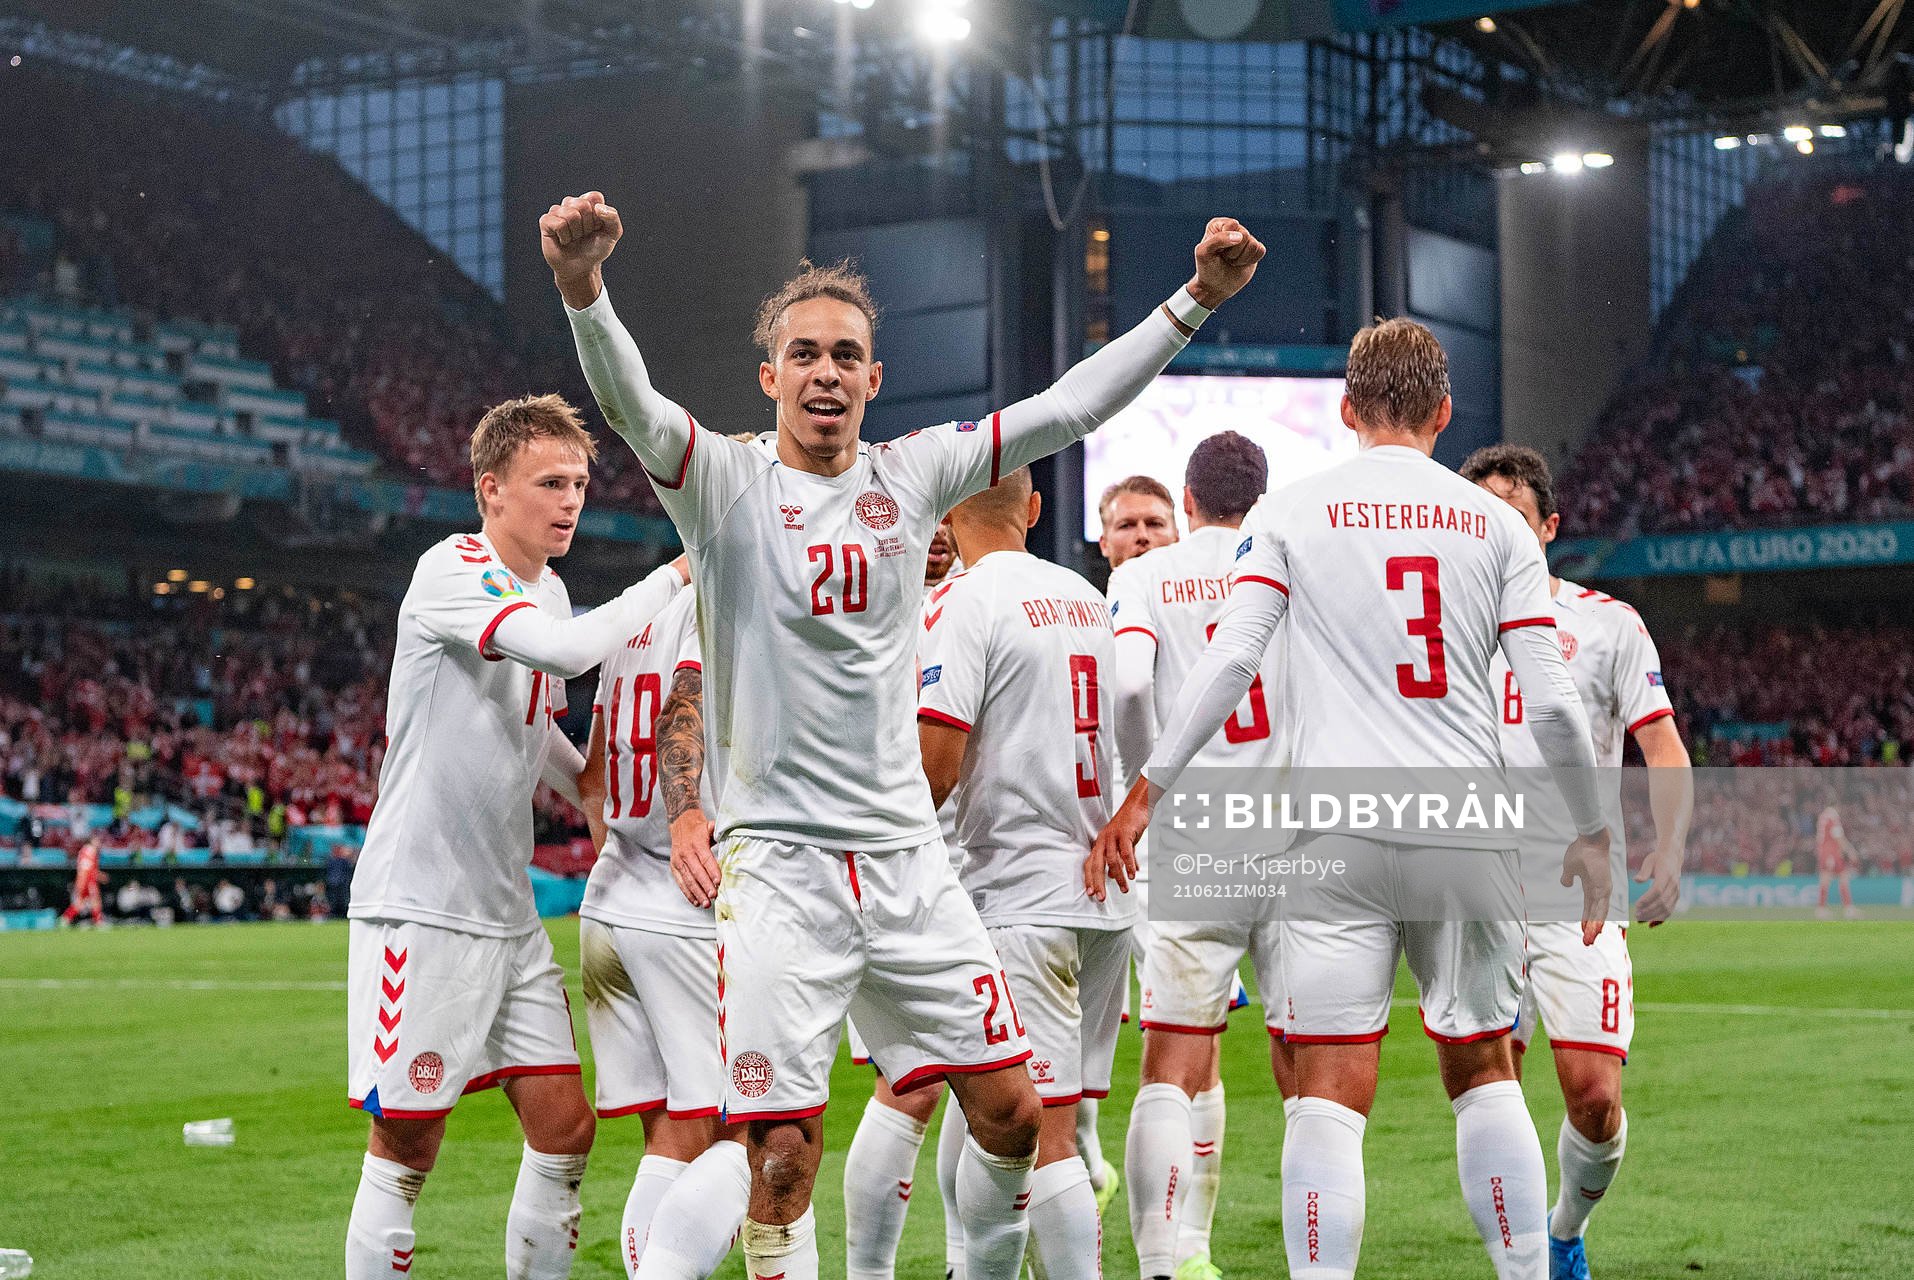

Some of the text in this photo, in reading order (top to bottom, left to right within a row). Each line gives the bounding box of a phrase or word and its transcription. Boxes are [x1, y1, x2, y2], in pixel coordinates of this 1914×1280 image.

[862, 504, 891, 517] DBU
[1327, 502, 1486, 540] VESTERGAARD
[1648, 528, 1898, 569] UEFA EURO 2020
[807, 544, 868, 616] 20
[1386, 556, 1448, 699] 3
[1503, 671, 1523, 724] 8
[608, 673, 661, 819] 18
[1069, 655, 1101, 799] 9
[1601, 978, 1619, 1034] 8
[415, 1065, 437, 1079] DBU
[741, 1067, 766, 1081] DBU
[1307, 1191, 1319, 1263] DANMARK
[1490, 1176, 1513, 1249] DANMARK
